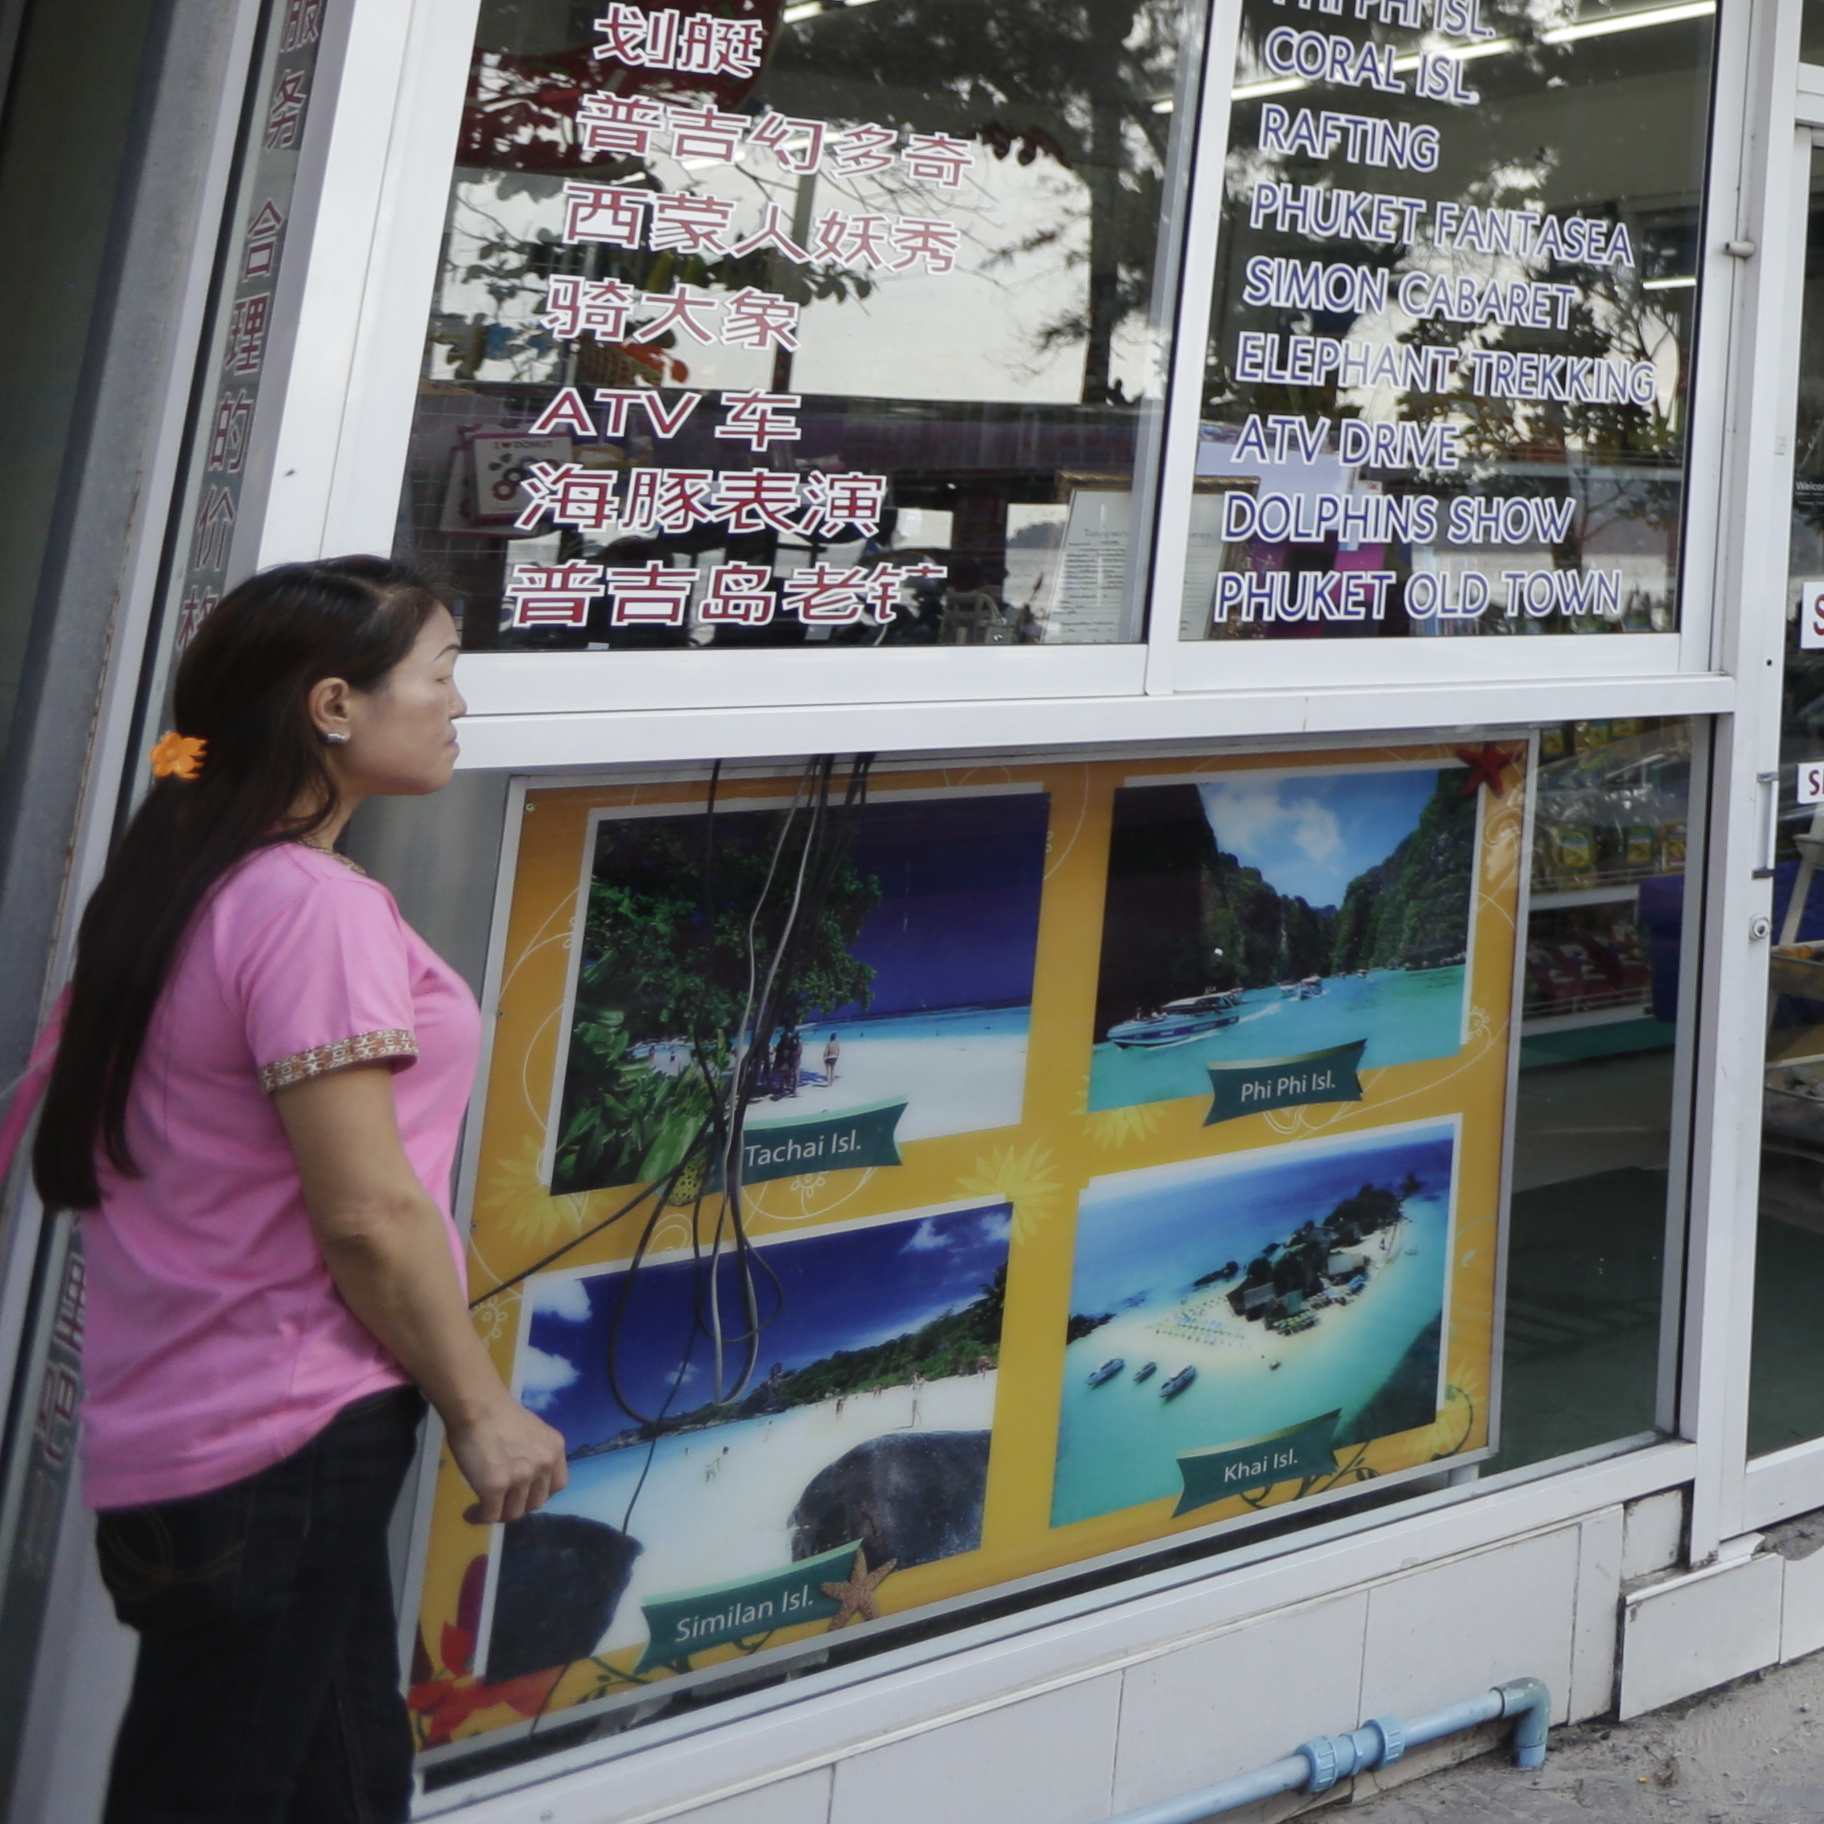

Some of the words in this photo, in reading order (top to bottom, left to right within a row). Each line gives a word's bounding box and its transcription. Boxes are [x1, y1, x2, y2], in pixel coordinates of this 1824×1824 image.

[593, 2, 764, 78] 划艇
[1264, 25, 1407, 95] CORAL
[1413, 49, 1481, 105] ISL.
[575, 90, 974, 189] 普吉幻多奇
[1257, 103, 1441, 173] RAFTING
[562, 181, 961, 274] 西蒙人妖秀
[1248, 182, 1427, 246] PHUKET
[1432, 199, 1637, 270] FANTASEA
[540, 273, 801, 352] 骑大象
[1241, 254, 1391, 316] SIMON
[1398, 271, 1577, 332] CABARET
[1234, 330, 1460, 395] ELEPHANT
[1466, 349, 1658, 406] TREKKING
[528, 387, 701, 438] ATV
[714, 387, 802, 452] 车
[1230, 413, 1331, 467] ATV
[1338, 418, 1461, 471] DRIVE
[514, 461, 888, 538] 海豚表演
[1220, 490, 1441, 545] DOLPHINS
[1446, 495, 1578, 546] SHOW
[1213, 570, 1396, 624] PHUKET
[1403, 569, 1491, 619] OLD
[1500, 567, 1625, 617] TOWN
[1239, 1079, 1274, 1104] Phi
[1276, 1075, 1308, 1099] Phi
[1309, 1070, 1337, 1094] Isl.
[745, 1138, 825, 1168] Tachai
[831, 1130, 863, 1155] Isl.
[1222, 1455, 1268, 1484] Khai
[1272, 1447, 1299, 1470] Isl.
[674, 1599, 775, 1644] Similan
[780, 1583, 815, 1616] Isl.
